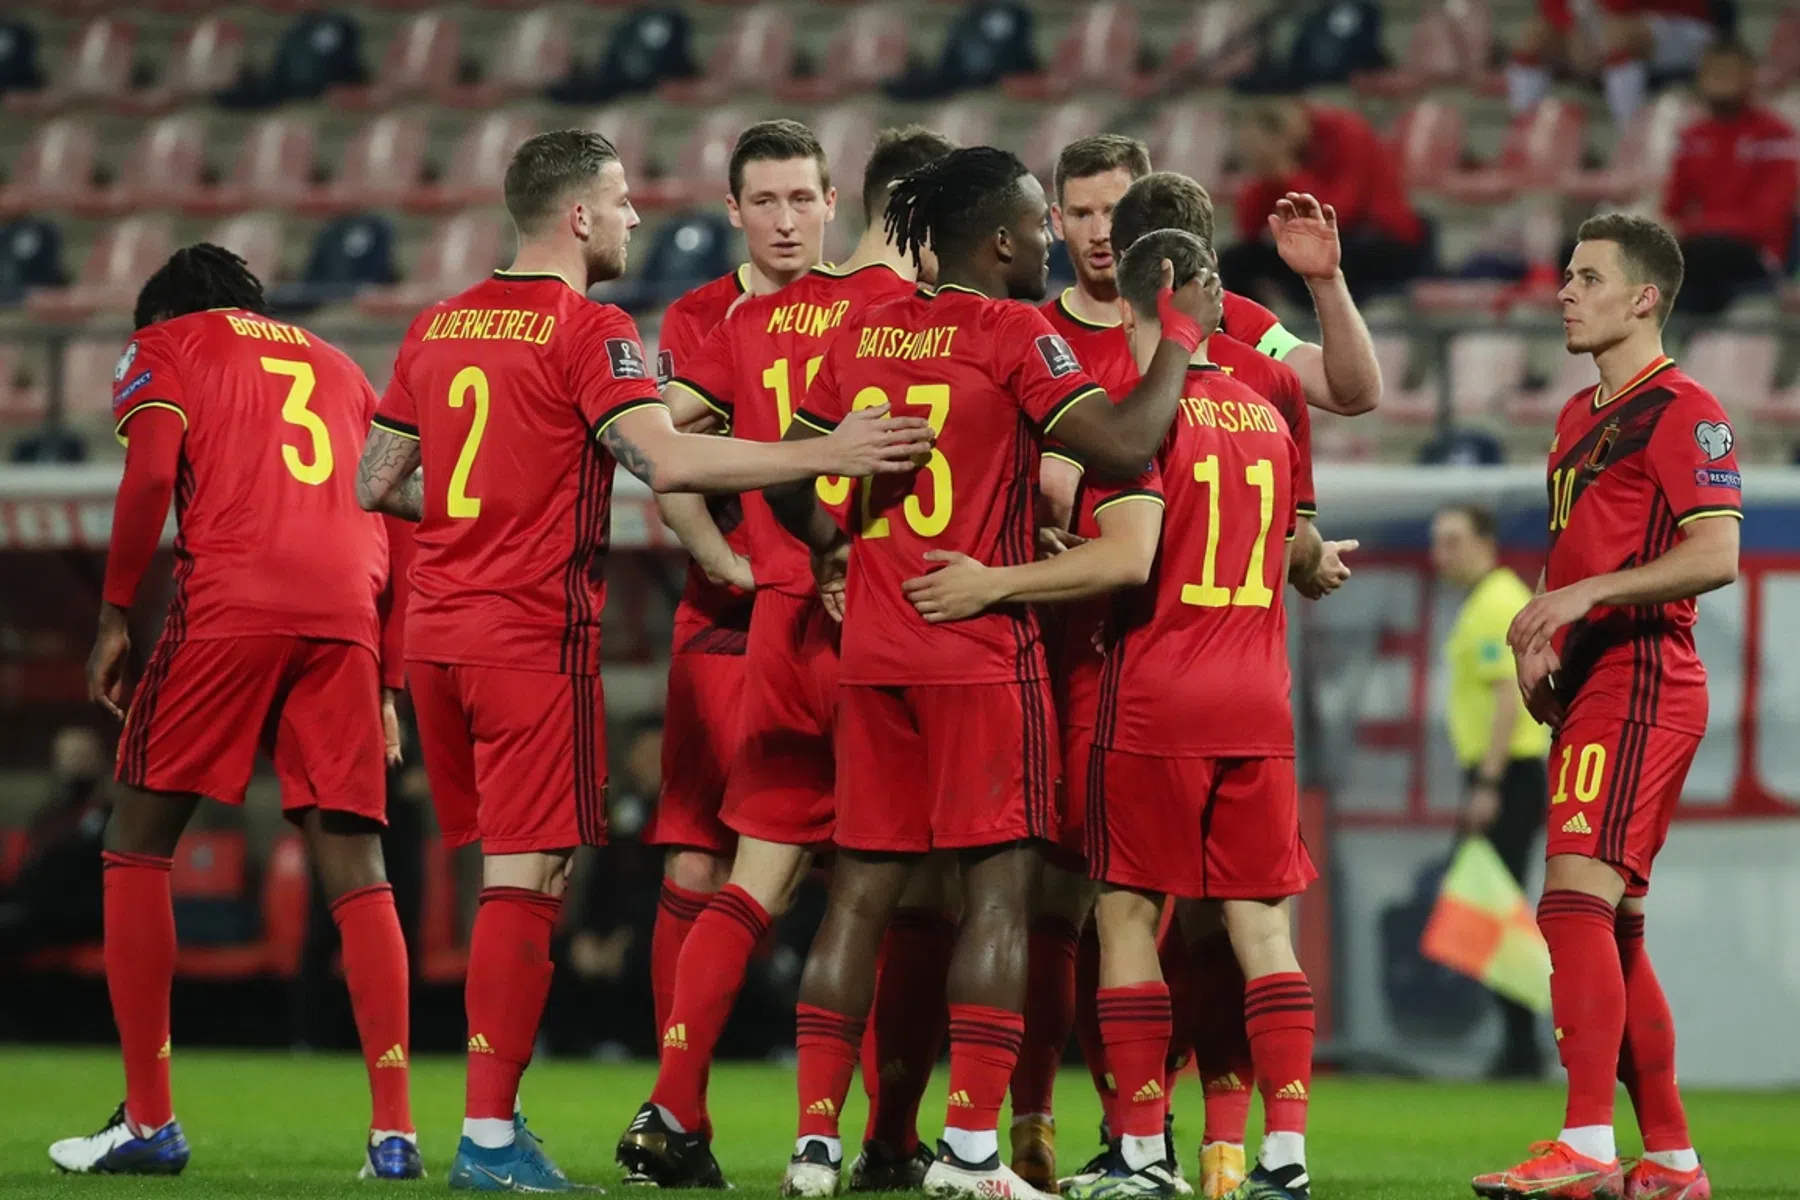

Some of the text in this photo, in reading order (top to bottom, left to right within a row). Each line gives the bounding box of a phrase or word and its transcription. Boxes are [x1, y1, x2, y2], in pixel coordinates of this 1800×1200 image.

[226, 315, 312, 347] BOYATA
[422, 309, 555, 345] ALDERWEIRELD
[856, 326, 958, 360] BATSHUAYI
[260, 356, 334, 486] 3
[446, 365, 490, 519] 2
[1549, 467, 1576, 531] 10
[1709, 473, 1741, 485] RESPECT
[1180, 454, 1274, 609] 11
[1550, 742, 1606, 805] 10
